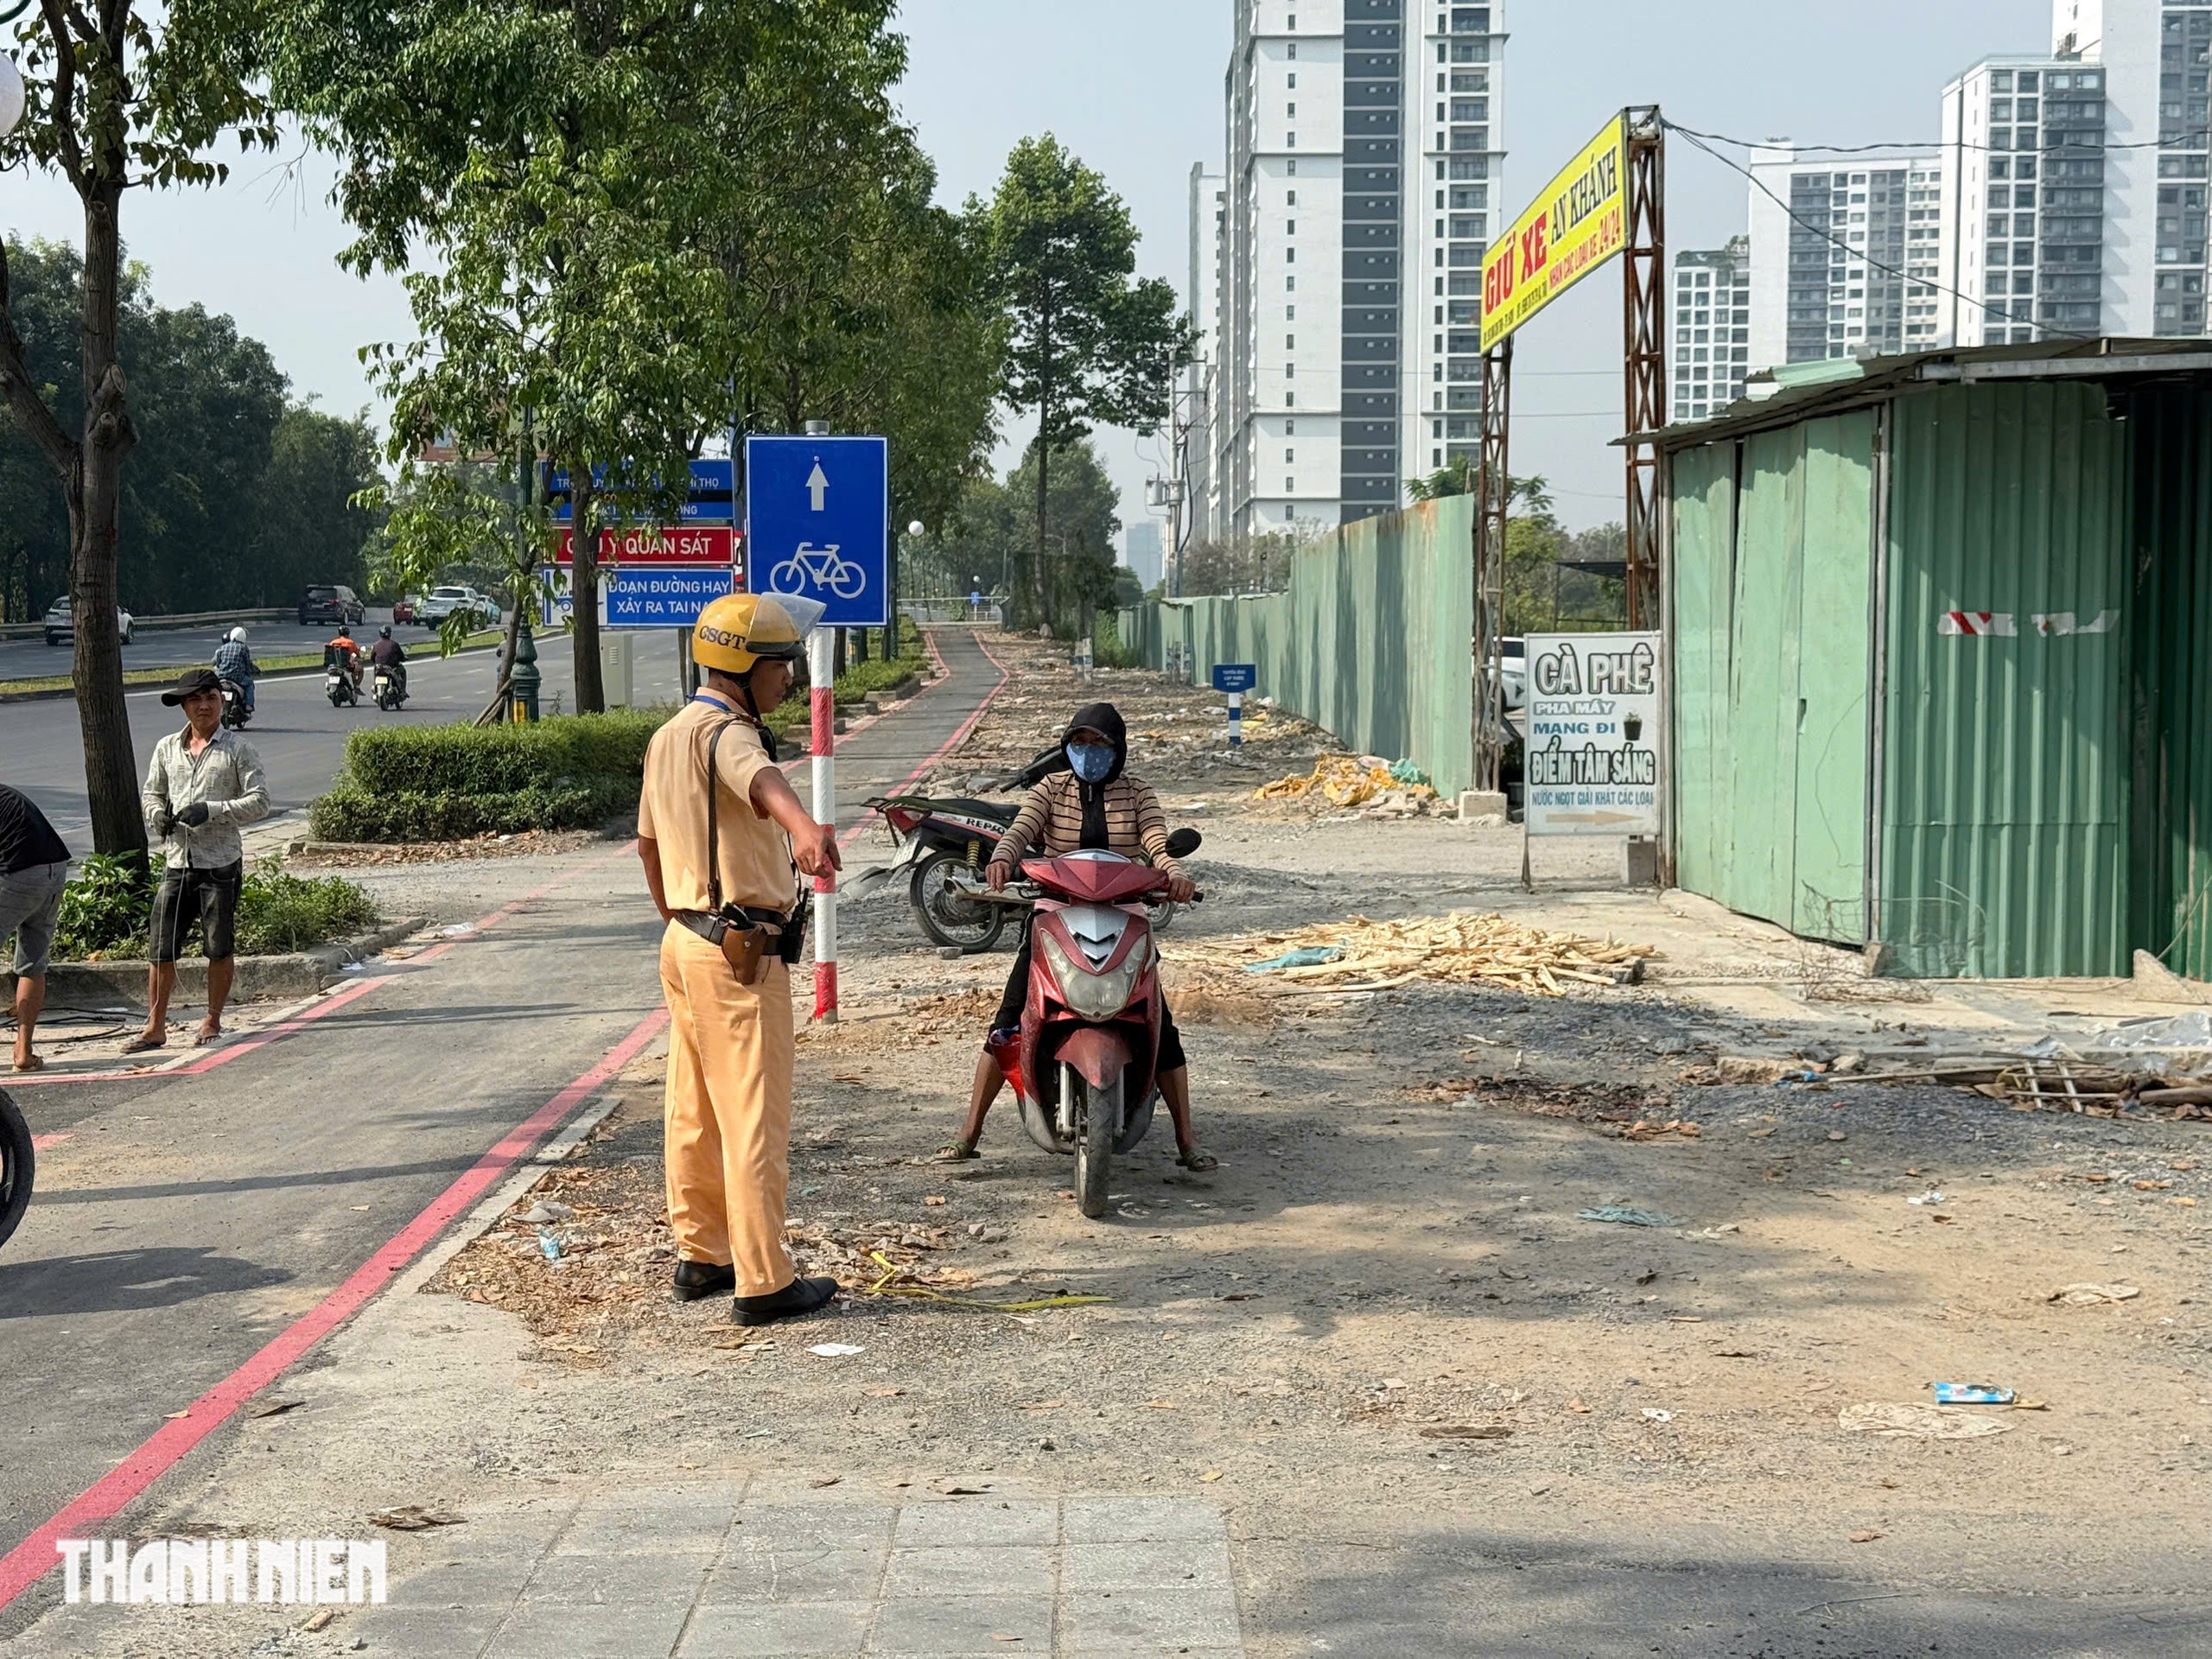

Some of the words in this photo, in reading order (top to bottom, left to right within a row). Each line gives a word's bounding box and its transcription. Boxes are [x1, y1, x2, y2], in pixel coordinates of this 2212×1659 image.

[1485, 231, 1516, 316] GIỮ
[1521, 210, 1548, 285] XE
[1550, 193, 1568, 245] AN
[1569, 145, 1618, 229] KHÁNH
[699, 478, 719, 489] THỌ
[626, 537, 676, 555] QUAN
[679, 531, 712, 555] SÁT
[608, 581, 647, 594] ĐOẠN
[650, 575, 700, 594] ĐƯỜNG
[702, 581, 729, 593] HAY
[616, 597, 642, 613] XẢY
[645, 601, 664, 613] RA
[668, 601, 688, 613] TAI
[699, 625, 747, 650] CSGT
[1535, 643, 1582, 696] CÀ
[1588, 642, 1655, 695] PHÊ
[1533, 701, 1572, 715] PHA
[1573, 698, 1617, 715] MÁY
[1534, 722, 1590, 734] MANG
[1595, 722, 1616, 734] ĐI
[1530, 734, 1573, 785] ĐIỂM
[1574, 742, 1611, 785] TÂM
[1611, 742, 1656, 785] SÁNG
[966, 817, 1006, 835] REPSO
